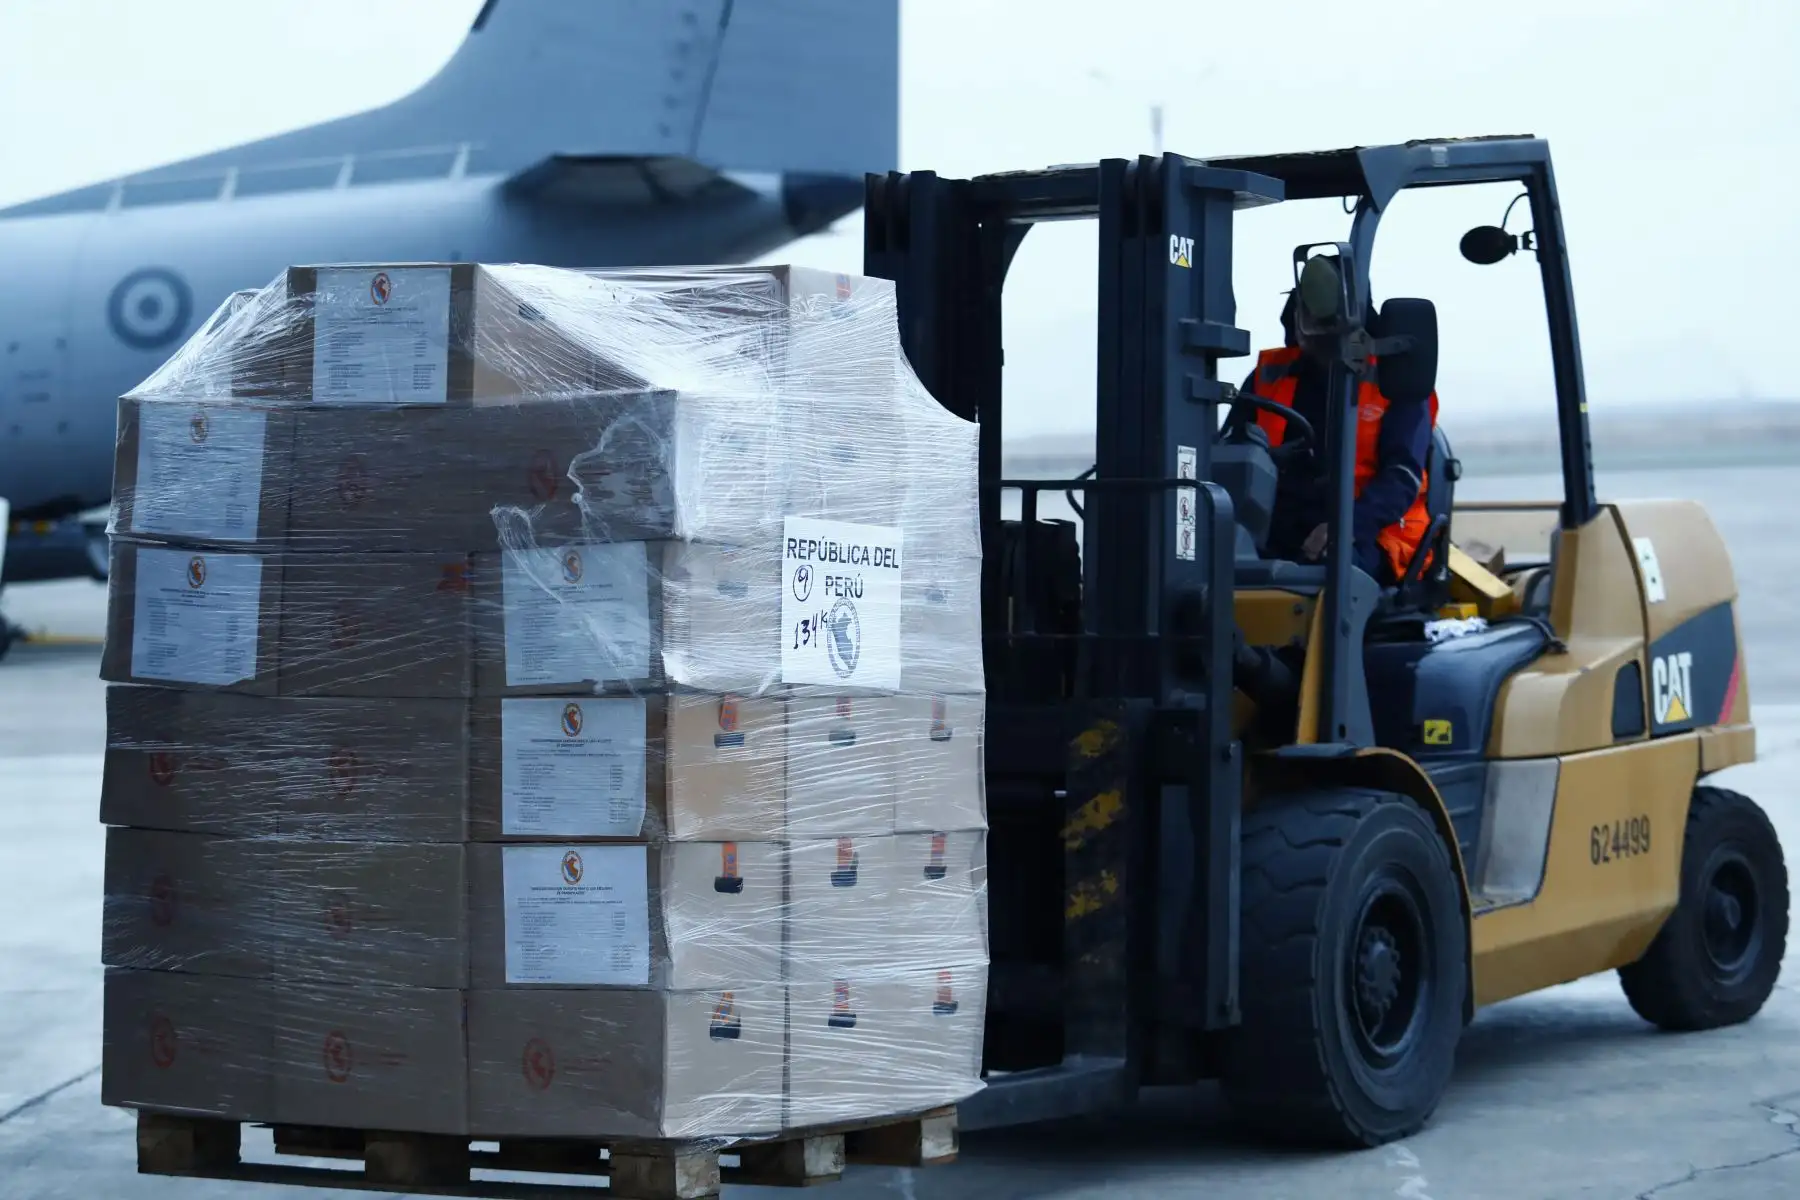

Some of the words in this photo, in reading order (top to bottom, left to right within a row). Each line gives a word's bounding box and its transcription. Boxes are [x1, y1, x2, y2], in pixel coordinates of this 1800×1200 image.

[1169, 235, 1195, 268] CAT
[787, 537, 870, 566] REPÚBLICA
[874, 547, 899, 569] DEL
[825, 573, 864, 599] PERÚ
[1652, 651, 1693, 724] CAT
[1589, 814, 1651, 866] 624499
